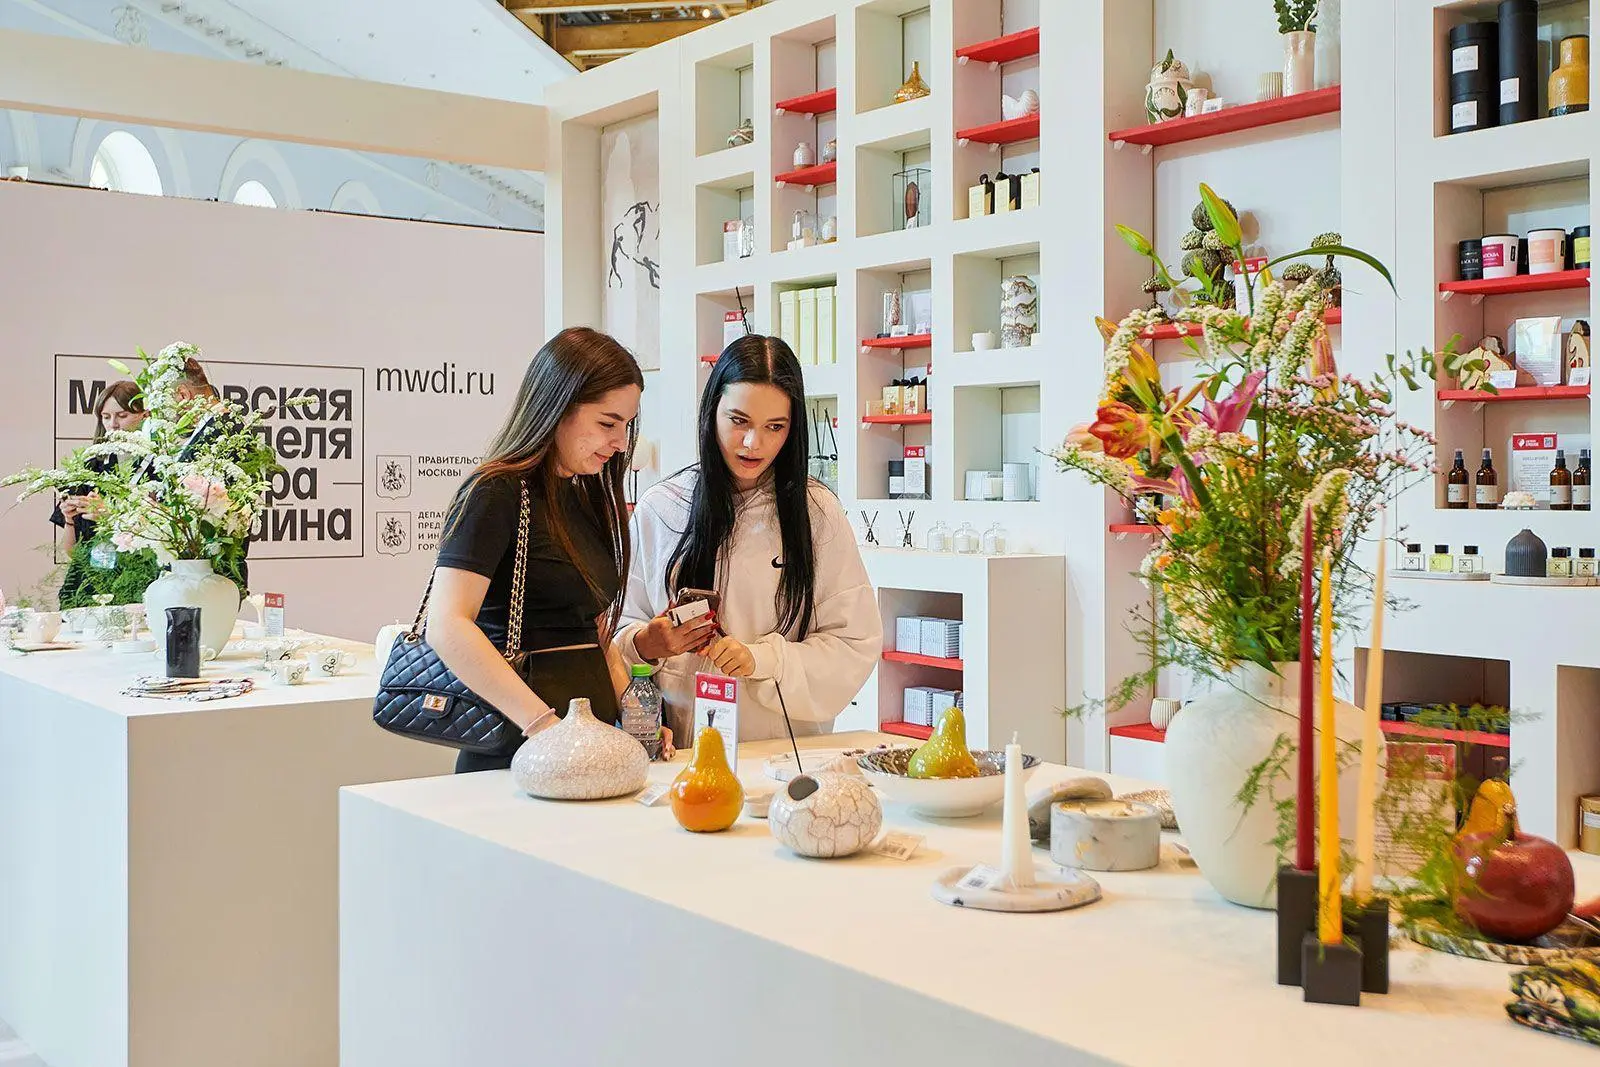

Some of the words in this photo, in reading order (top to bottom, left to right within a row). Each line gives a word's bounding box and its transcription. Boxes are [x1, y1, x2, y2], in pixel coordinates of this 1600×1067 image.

[376, 362, 495, 395] mwdi.ru
[69, 379, 353, 421] Мвская
[418, 456, 484, 465] ПРАВИТЕЛЬСТ
[418, 468, 462, 477] МОСКВЫ
[249, 503, 353, 542] айна
